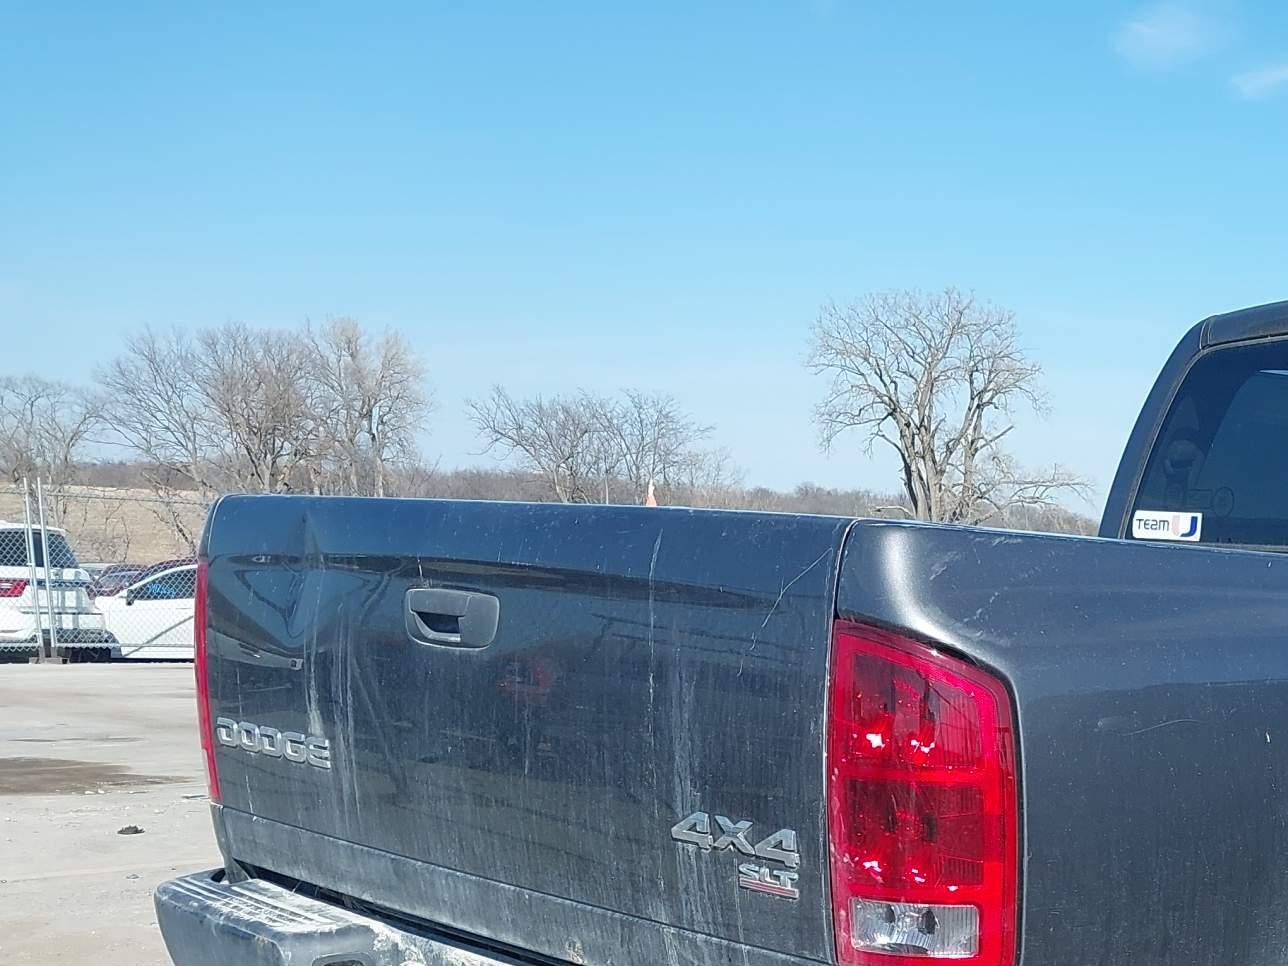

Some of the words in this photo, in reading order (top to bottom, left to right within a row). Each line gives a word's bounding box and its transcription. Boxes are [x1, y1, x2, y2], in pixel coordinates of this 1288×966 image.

[216, 716, 331, 770] DODGE
[671, 811, 800, 868] 4X4
[739, 863, 799, 889] SLT
